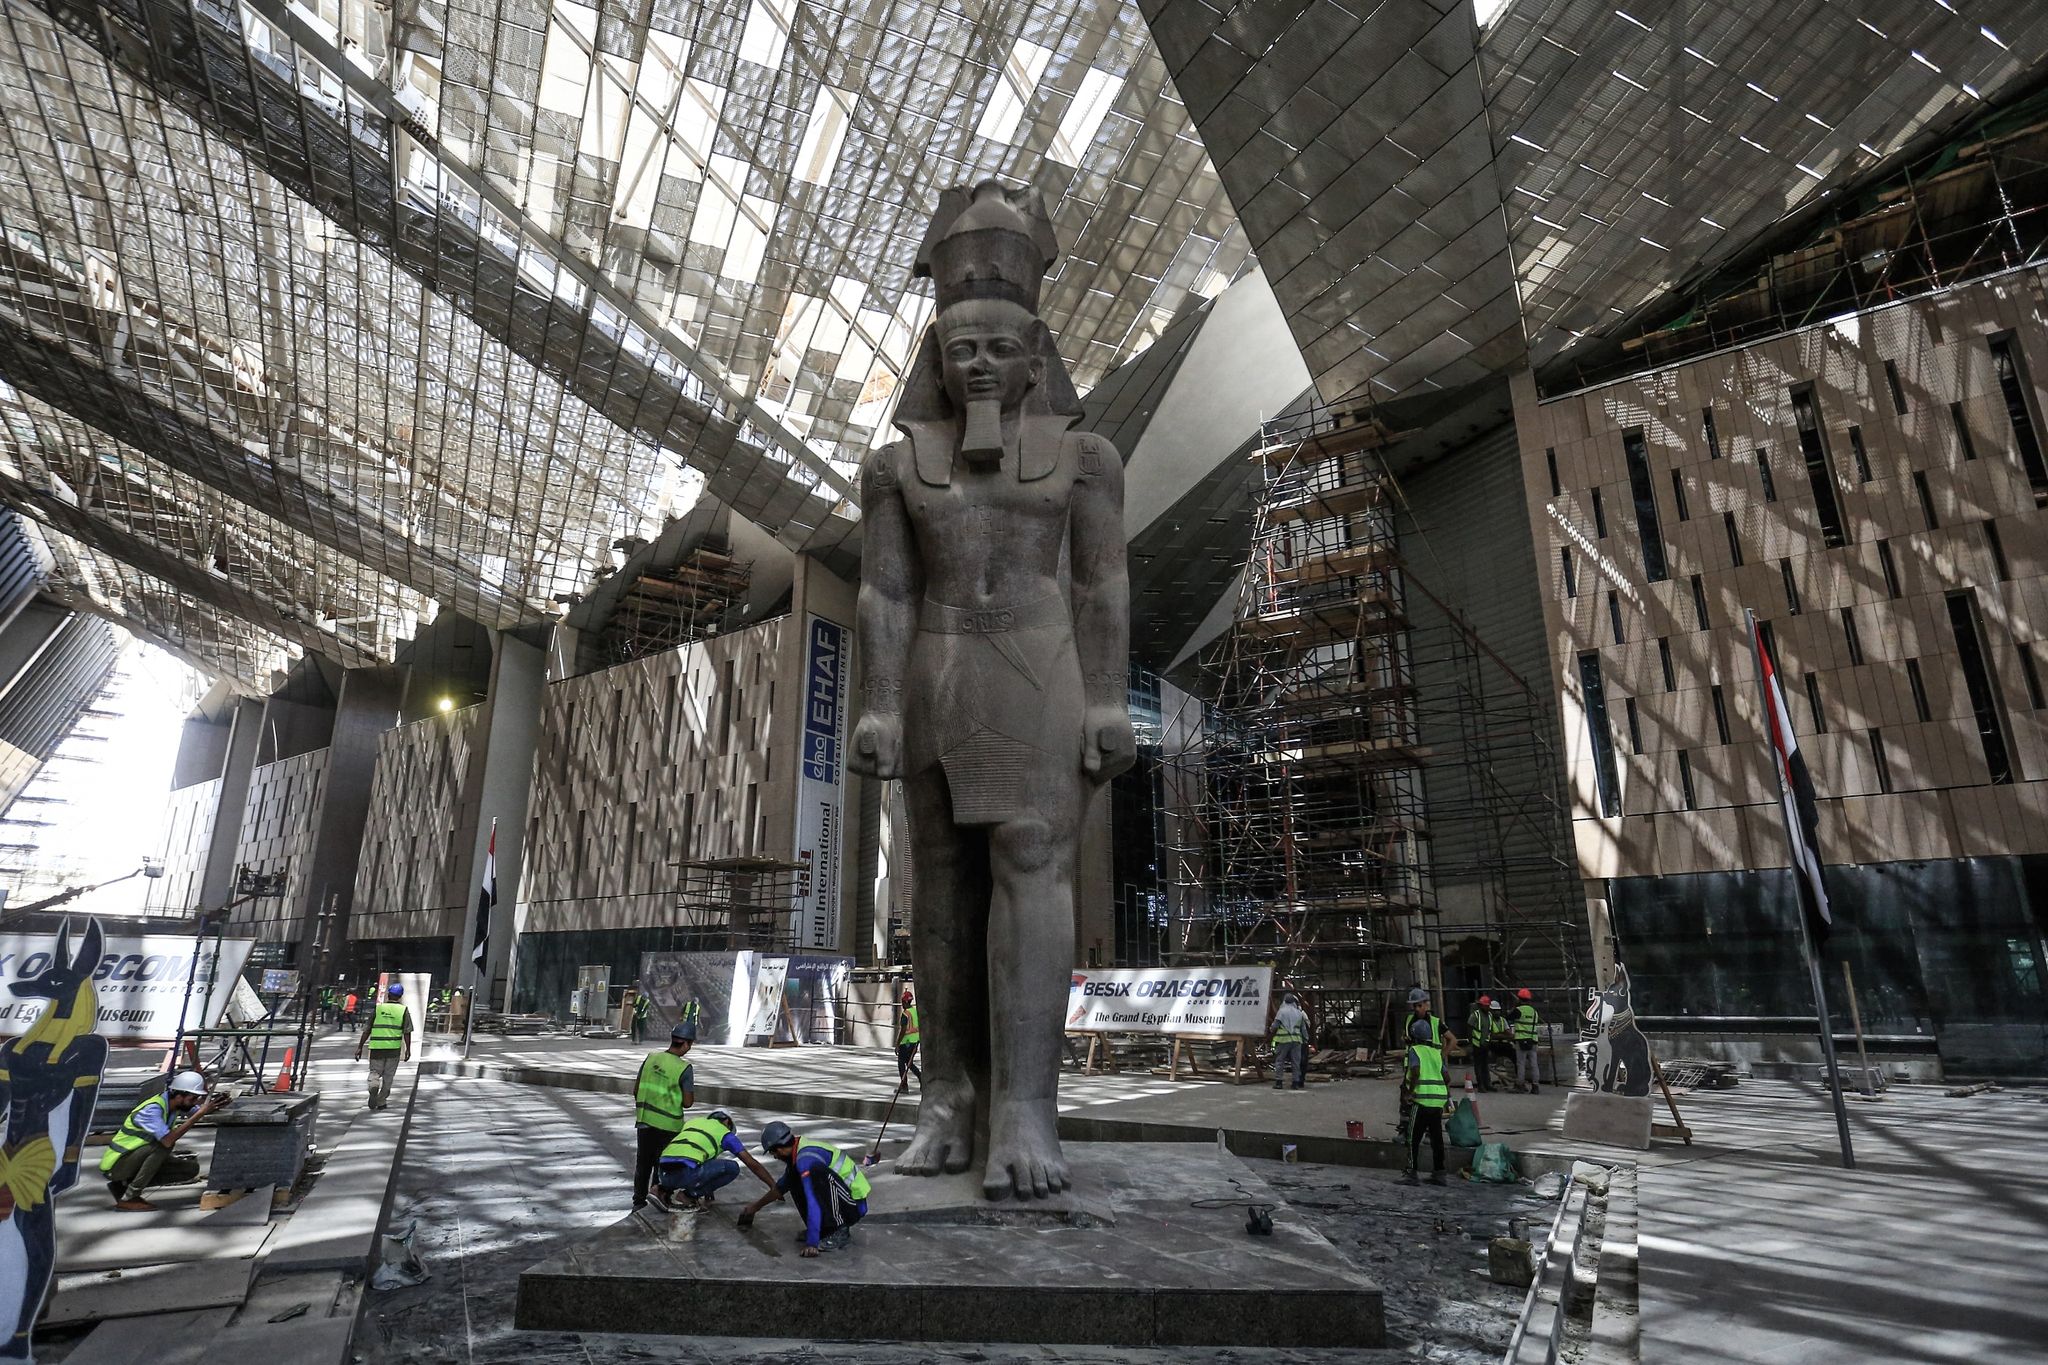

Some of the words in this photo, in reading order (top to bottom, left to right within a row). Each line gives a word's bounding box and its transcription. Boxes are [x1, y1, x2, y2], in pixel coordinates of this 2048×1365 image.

[813, 628, 836, 726] EHAF
[834, 705, 843, 786] CONSULTING
[839, 629, 848, 698] ENGINEERS
[816, 802, 831, 911] International
[814, 916, 825, 947] Hill
[1083, 982, 1133, 997] BESIX
[1136, 978, 1243, 998] ORASCOM
[127, 1024, 148, 1032] Project
[1095, 1012, 1109, 1022] The
[1112, 1012, 1140, 1023] Grand
[1141, 1012, 1181, 1026] Egyptian
[1184, 1013, 1226, 1025] Museum
